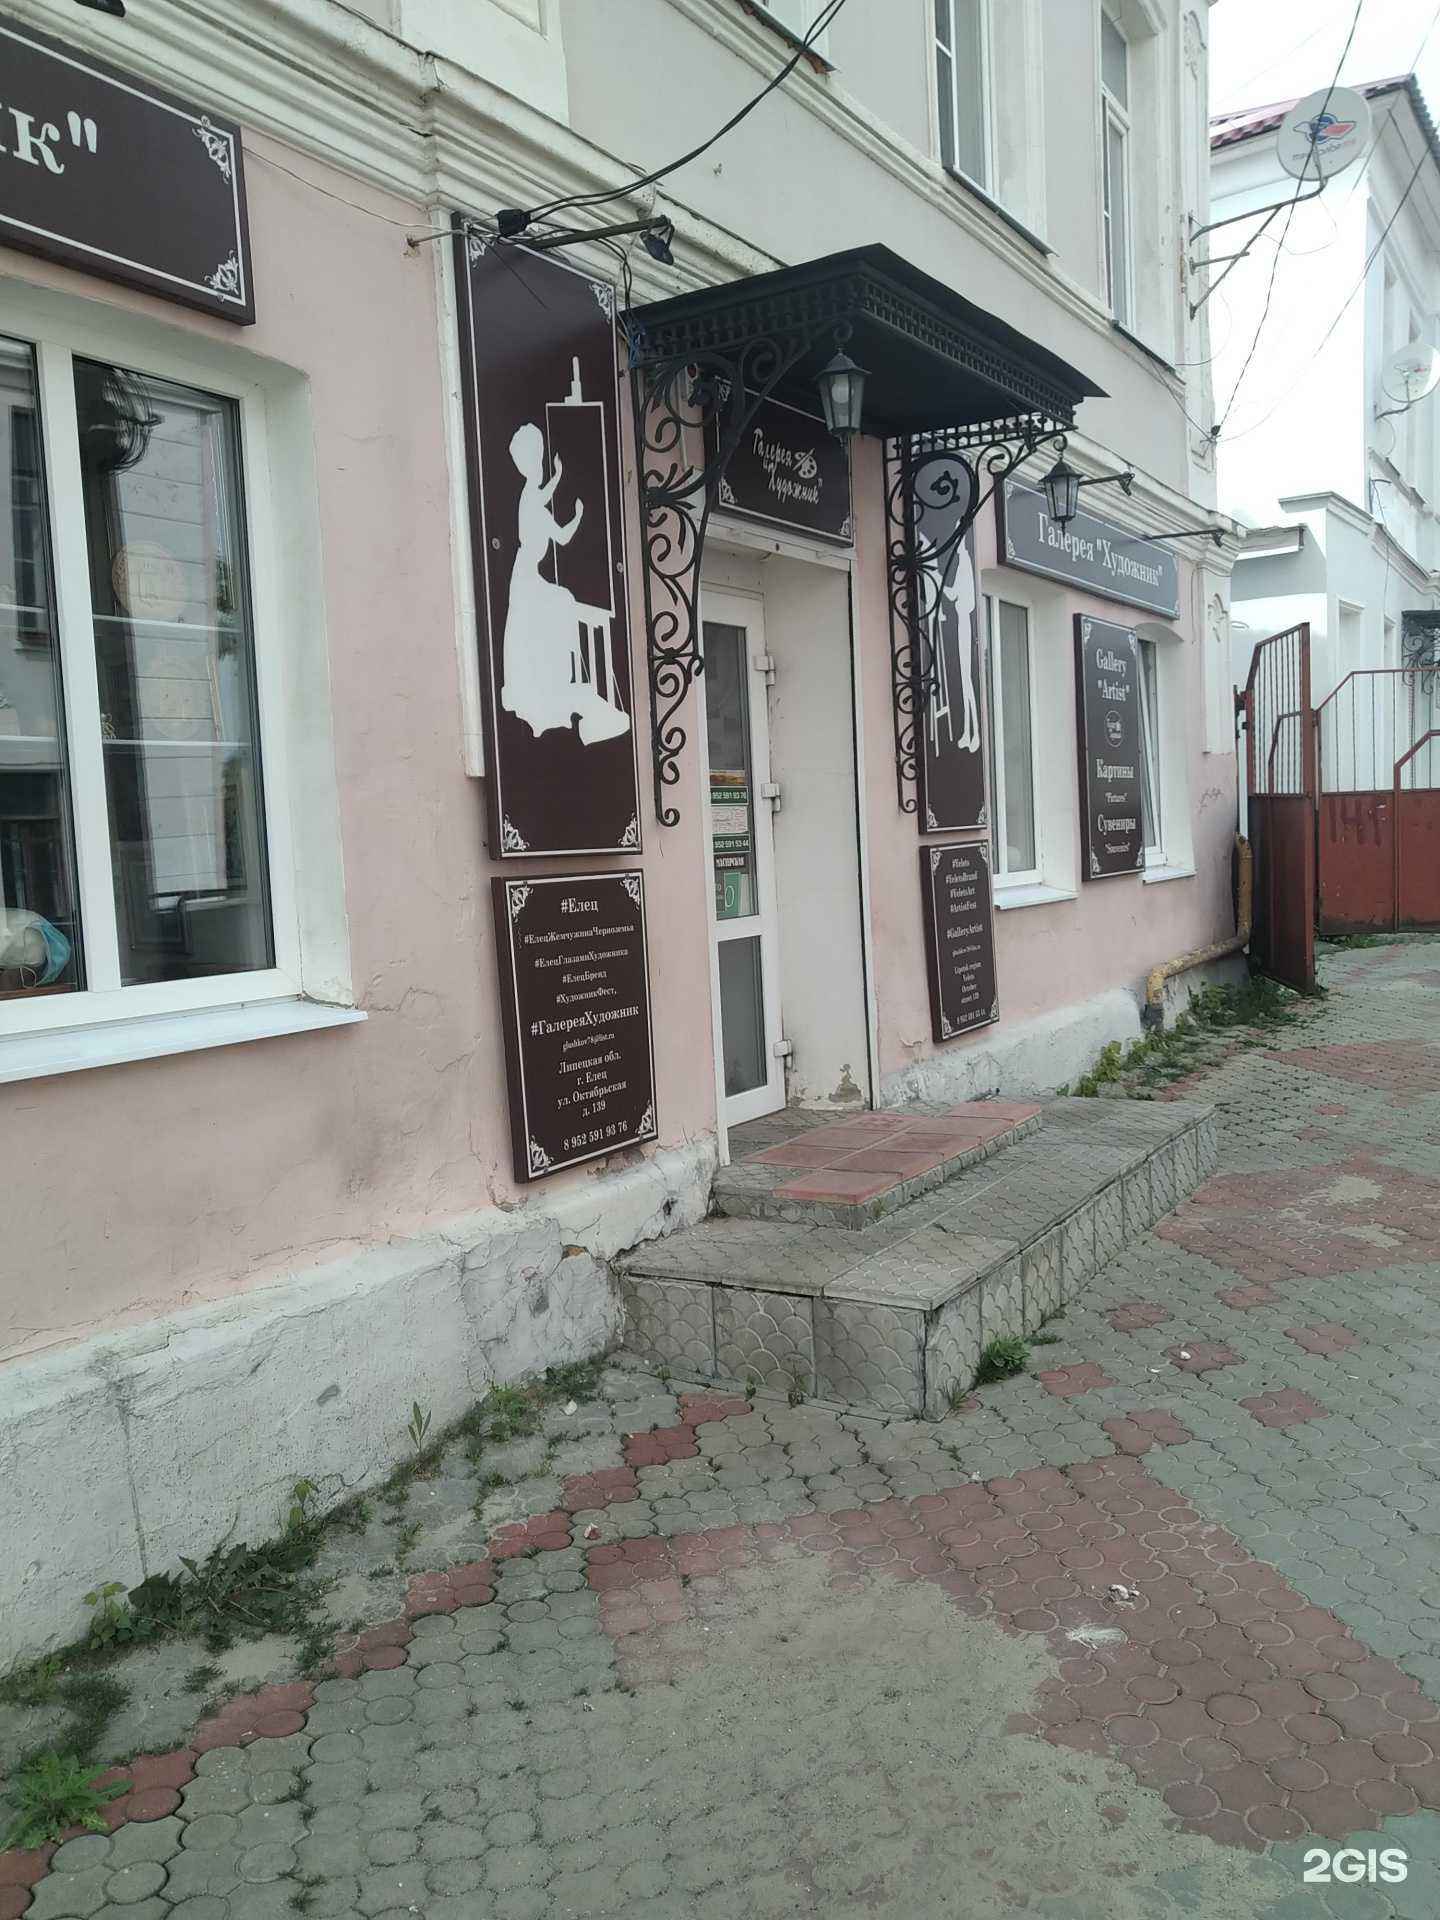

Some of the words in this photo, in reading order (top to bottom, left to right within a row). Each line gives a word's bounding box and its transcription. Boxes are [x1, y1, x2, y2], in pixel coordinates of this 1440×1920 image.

[1038, 512, 1094, 562] Галерея
[1096, 538, 1163, 587] "Художник"
[1095, 647, 1128, 680] Gallery
[1097, 679, 1130, 703] "Artist"
[1095, 758, 1135, 784] Картины
[1097, 813, 1137, 840] Сувениры
[561, 897, 599, 915] #Елец
[524, 922, 635, 946] #ЕлецЖемчужинаЧерноземья
[534, 947, 629, 969] #ЕлецГлазамиХудожника
[561, 969, 608, 985] #ЕлецБренд
[530, 1004, 640, 1038] #ГалереяХудожник
[558, 1055, 604, 1075] Липецкая
[604, 1050, 622, 1065] обл.
[576, 1073, 585, 1086] г.
[586, 1070, 608, 1085] Елец
[557, 1093, 571, 1108] ул.
[572, 1080, 628, 1104] Октябрьская
[582, 1107, 592, 1119] д.
[593, 1099, 607, 1114] 139
[563, 1137, 570, 1151] 8
[571, 1132, 588, 1149] 952
[588, 1127, 605, 1145] 591
[605, 1123, 617, 1141] 93
[617, 1119, 629, 1135] 76
